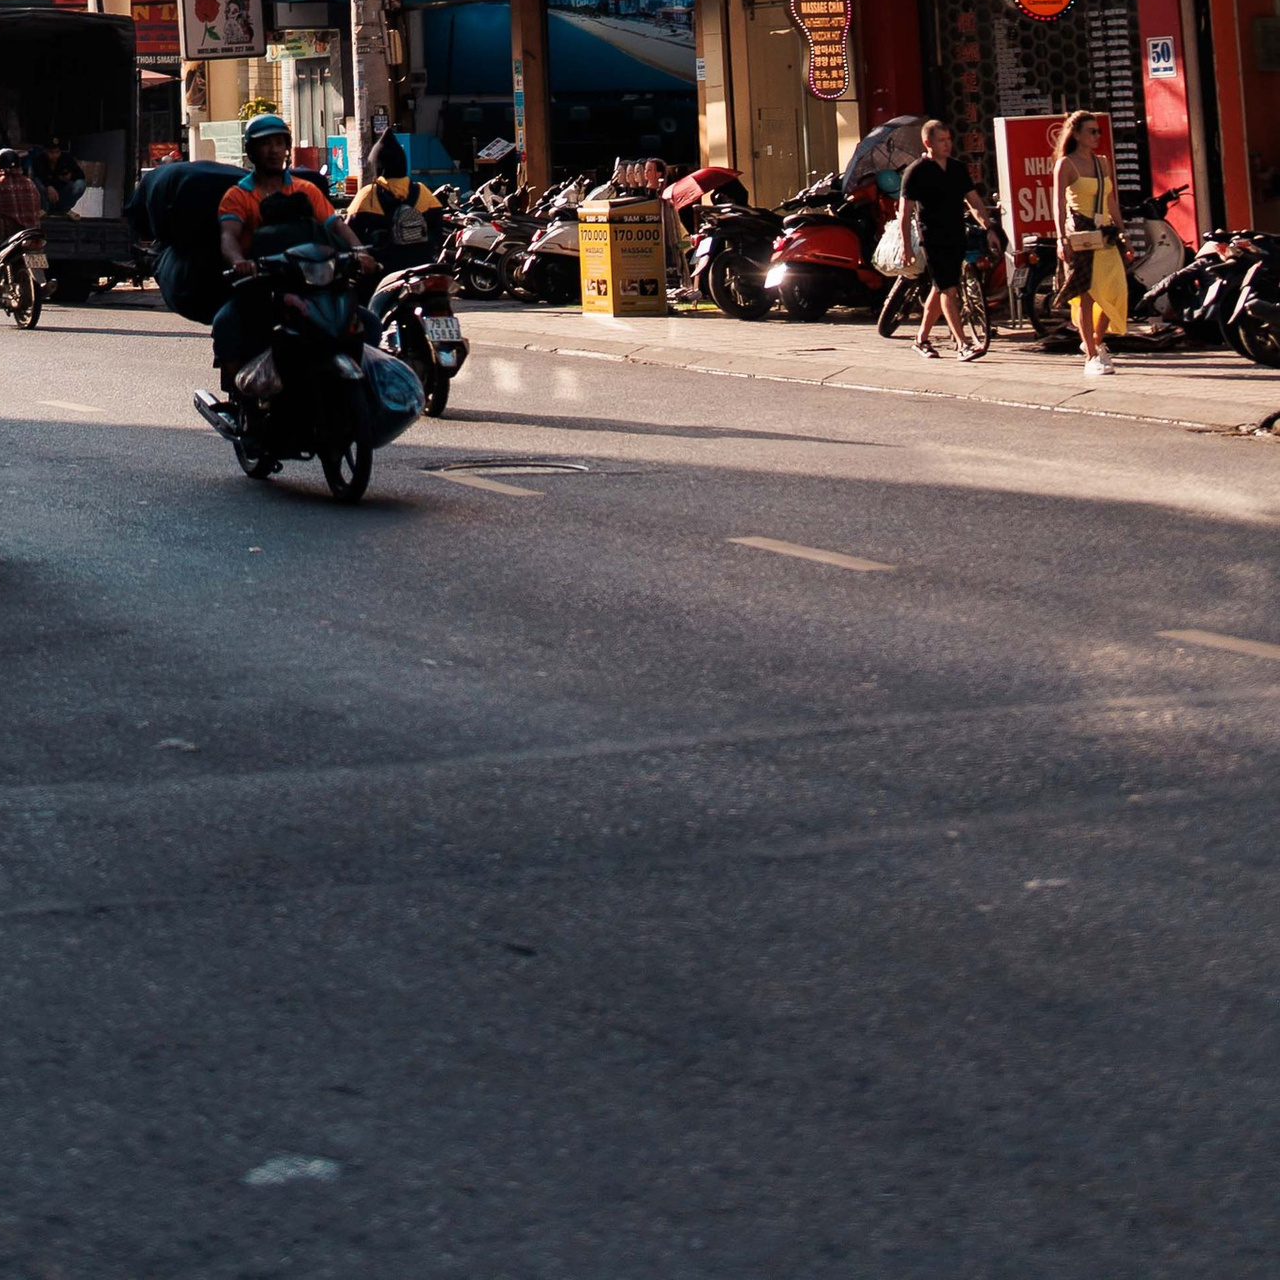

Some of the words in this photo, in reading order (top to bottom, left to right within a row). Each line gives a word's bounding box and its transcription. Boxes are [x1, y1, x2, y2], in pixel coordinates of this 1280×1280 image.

[801, 1, 829, 13] MASSAGE
[1152, 41, 1171, 64] 50
[1024, 157, 1053, 176] NHA
[581, 229, 608, 241] 170.000
[613, 229, 660, 241] 170.000
